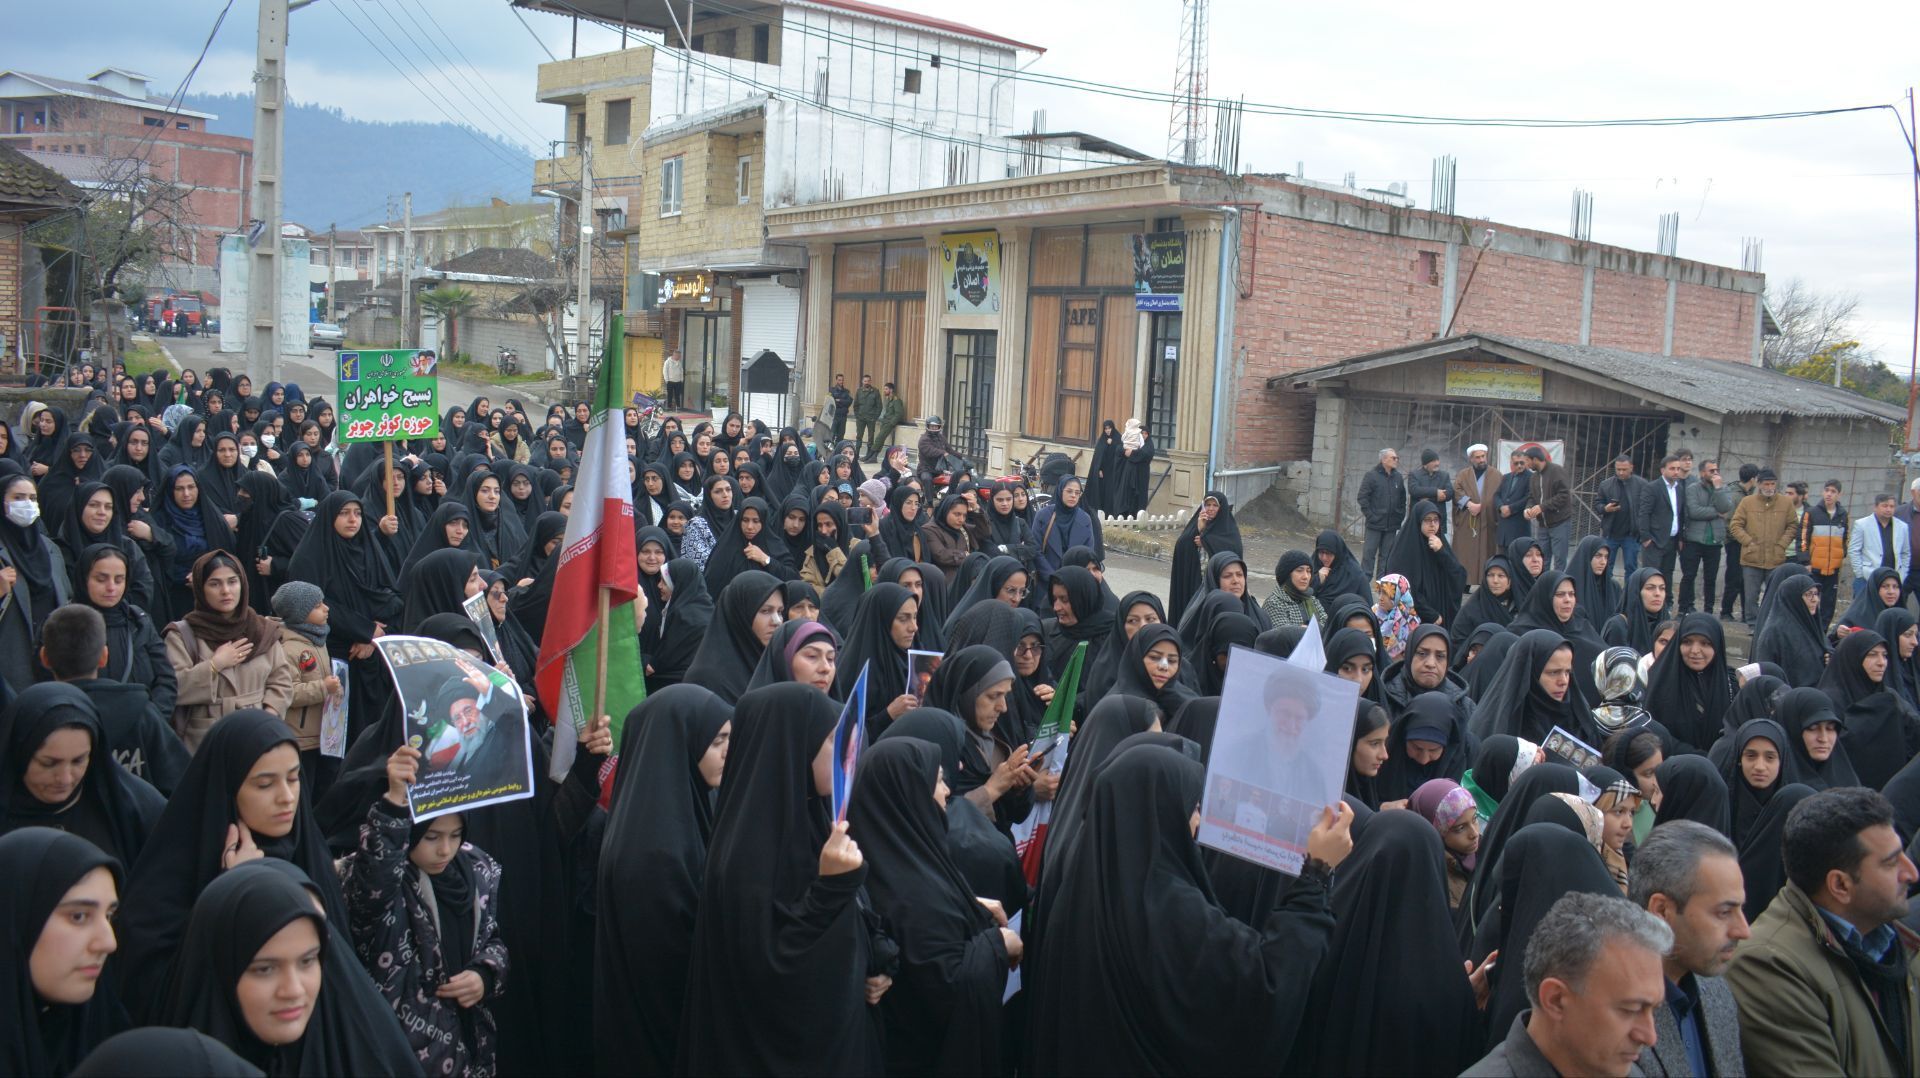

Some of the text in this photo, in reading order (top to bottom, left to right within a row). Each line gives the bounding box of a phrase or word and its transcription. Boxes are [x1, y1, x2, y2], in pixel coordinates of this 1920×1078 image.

[1161, 249, 1184, 269] اصلان
[963, 272, 980, 289] اصلان
[345, 384, 432, 410] بسیج خواهران
[346, 413, 433, 438] حوزه کوثر چوبر
